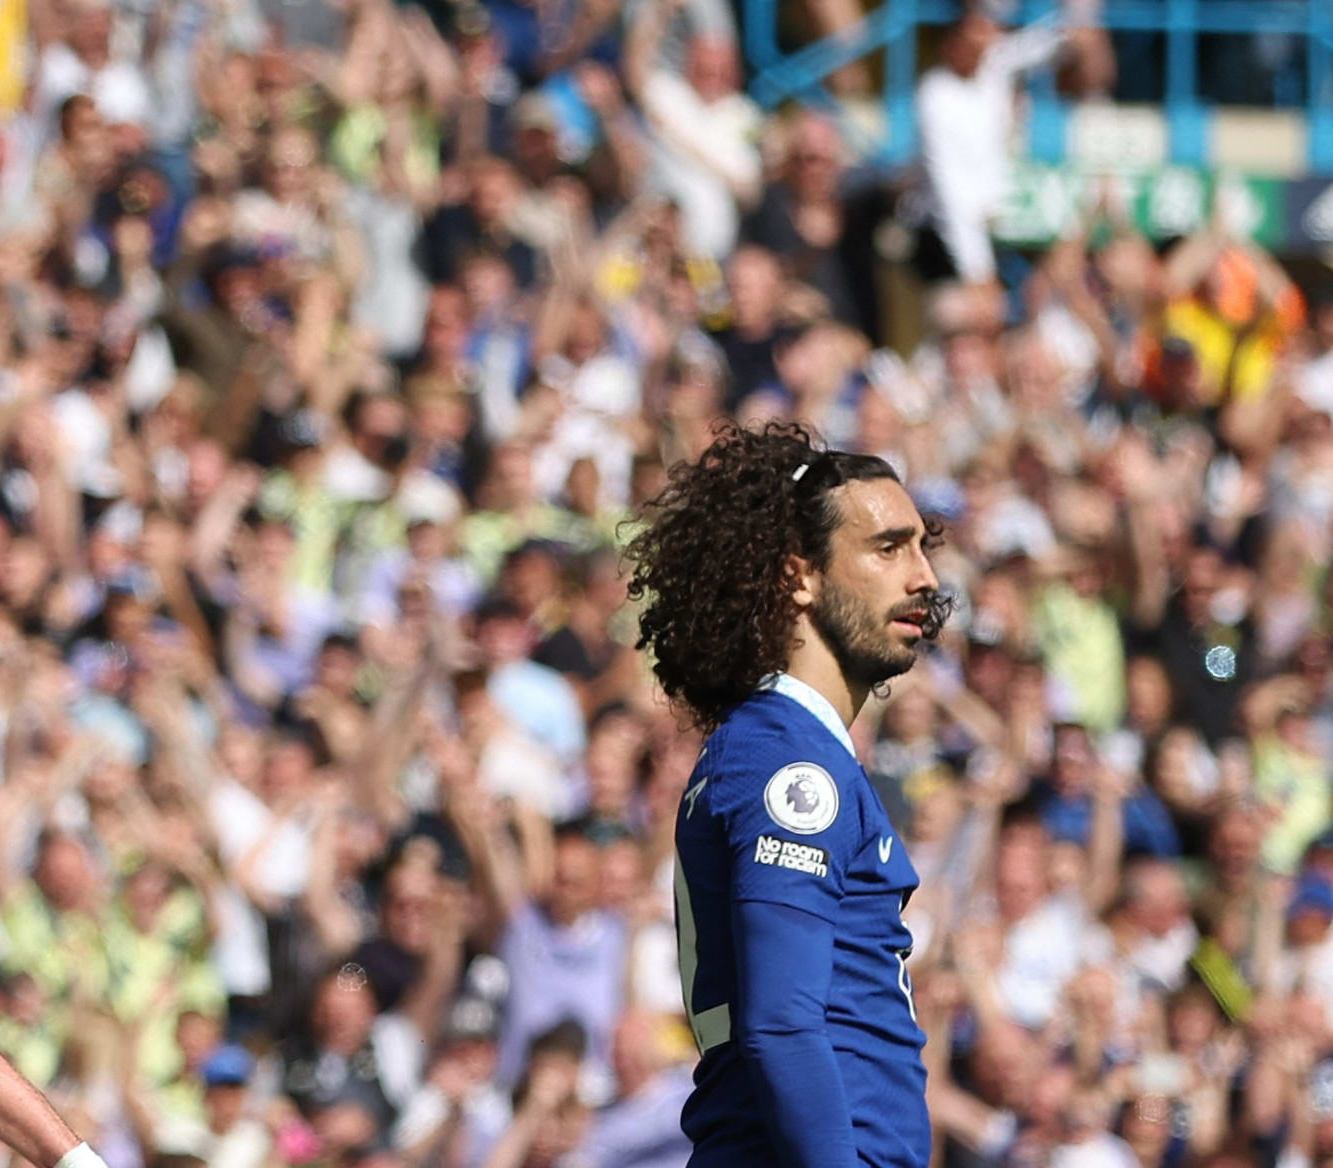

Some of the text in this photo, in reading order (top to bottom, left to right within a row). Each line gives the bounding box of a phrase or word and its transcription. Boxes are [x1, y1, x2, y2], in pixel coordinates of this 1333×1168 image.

[754, 846, 828, 878] for racism
[757, 835, 824, 864] No room
